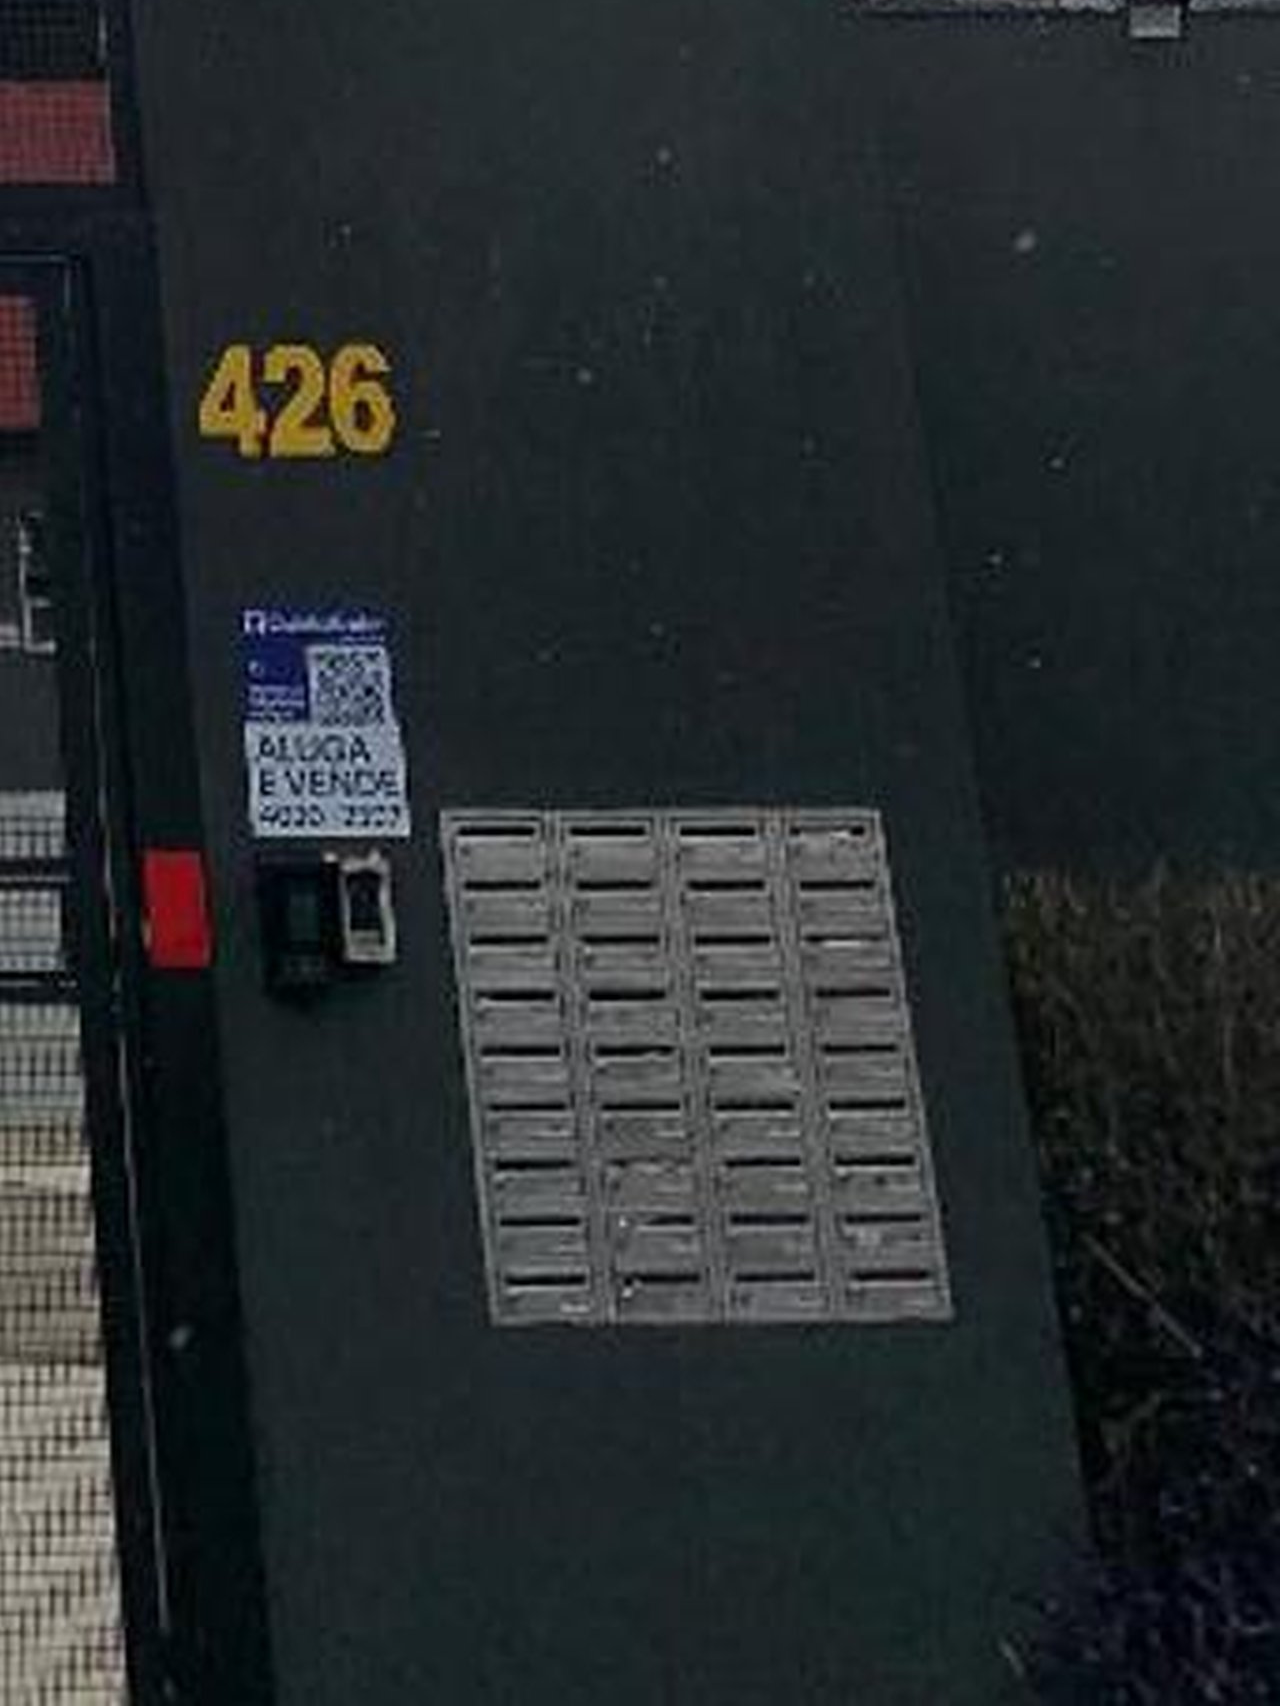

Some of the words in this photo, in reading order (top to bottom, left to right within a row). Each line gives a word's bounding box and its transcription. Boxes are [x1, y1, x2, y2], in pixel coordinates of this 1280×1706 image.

[198, 343, 397, 458] 426
[255, 735, 371, 763] ALUGA
[259, 769, 276, 796] E
[283, 769, 400, 797] VENDE
